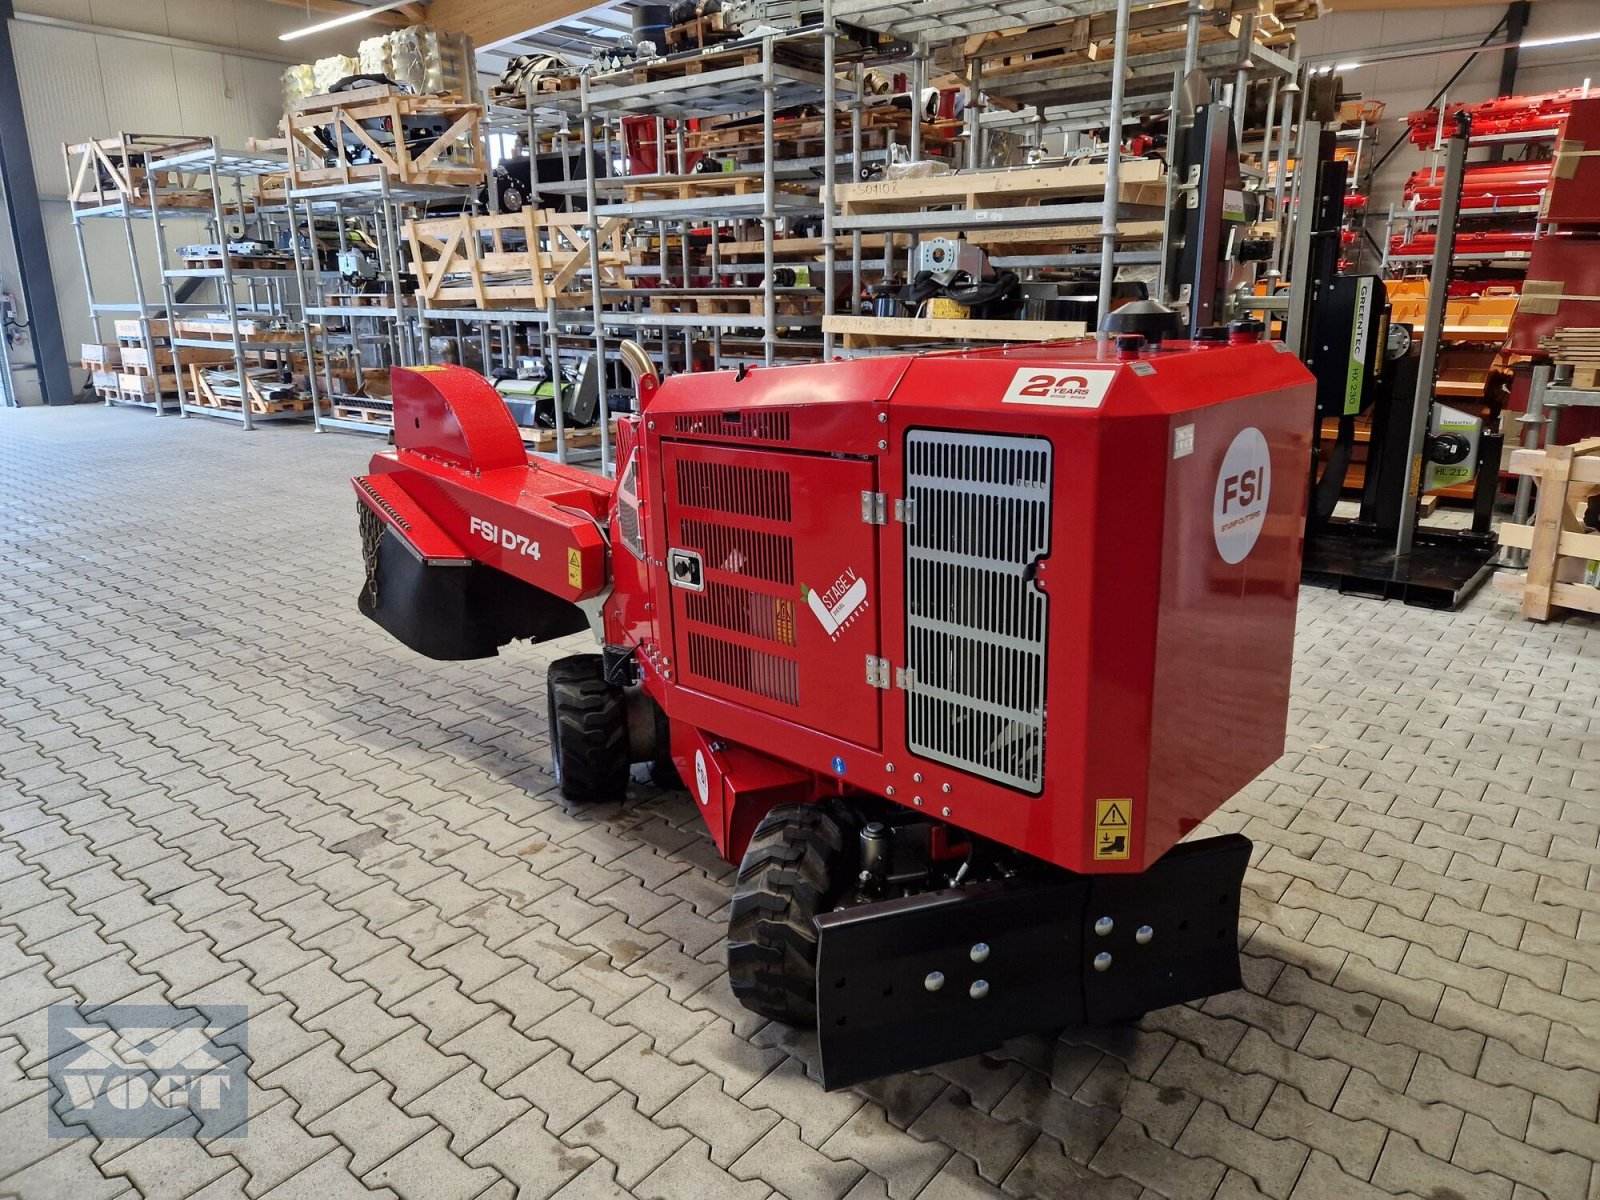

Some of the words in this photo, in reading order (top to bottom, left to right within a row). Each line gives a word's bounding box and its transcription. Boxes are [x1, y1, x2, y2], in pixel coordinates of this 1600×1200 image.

[1354, 286, 1368, 355] GREENTEC
[1352, 368, 1359, 381] HX
[1053, 387, 1090, 395] YEARS
[1349, 385, 1358, 404] 230
[1435, 468, 1448, 476] HL
[1449, 468, 1469, 477] 212
[1222, 466, 1264, 515] FSI
[470, 516, 498, 544] FSI
[502, 528, 541, 561] D74
[822, 574, 851, 609] STAGE
[845, 566, 857, 581] V
